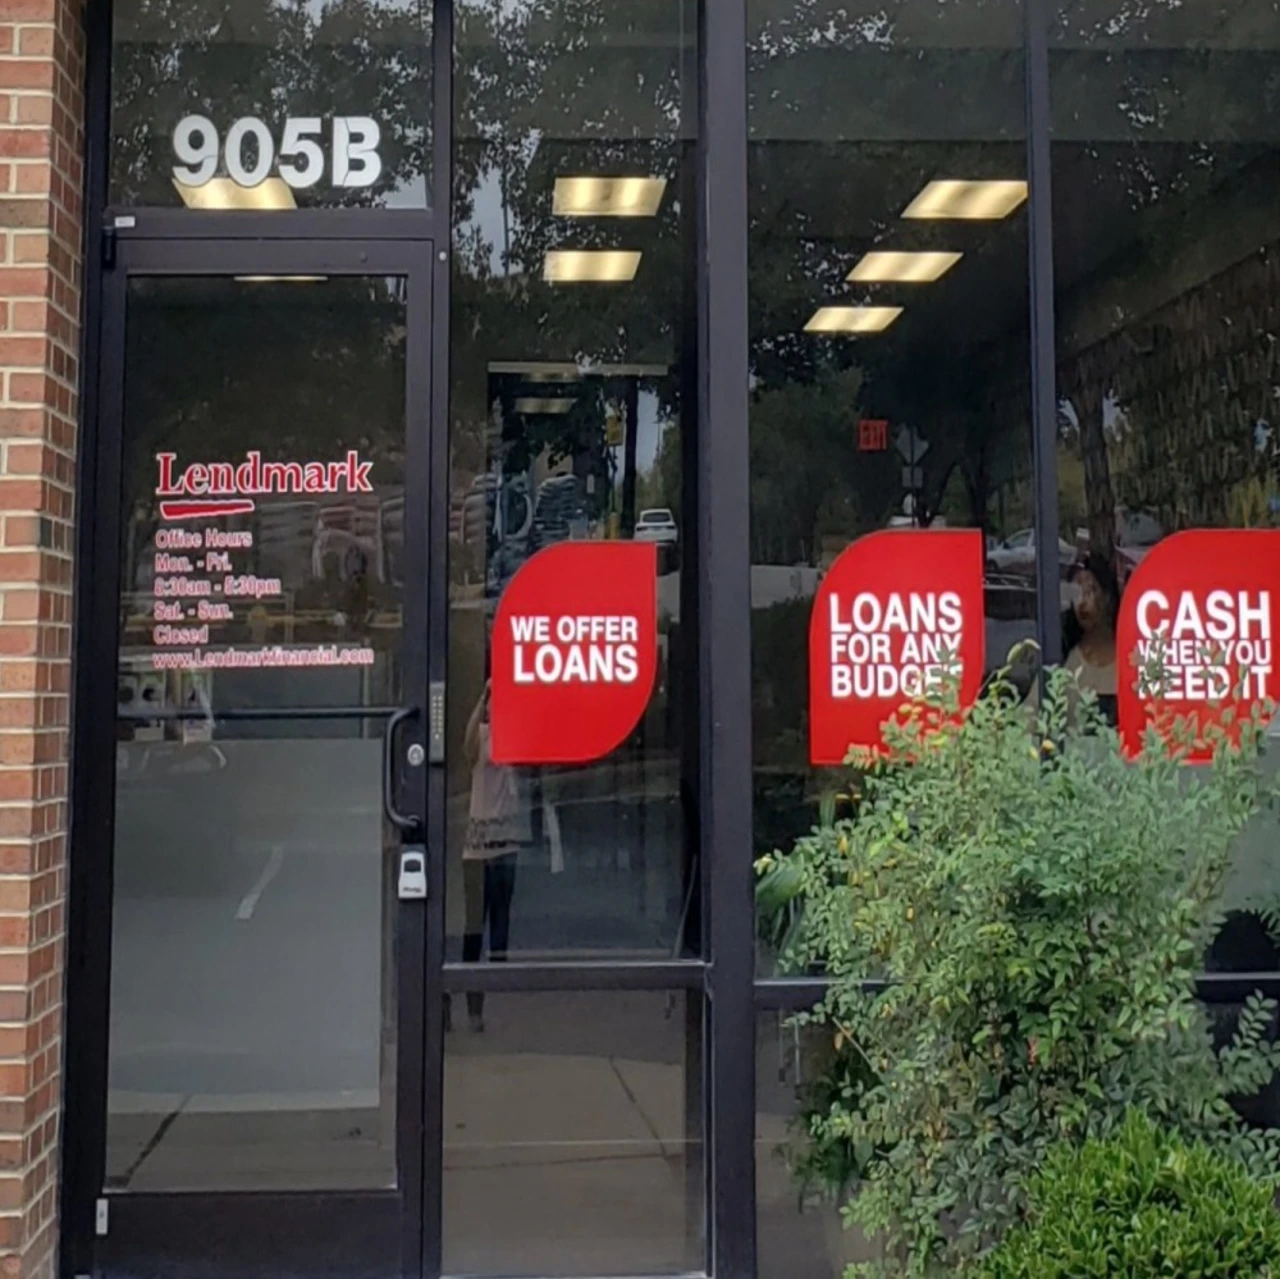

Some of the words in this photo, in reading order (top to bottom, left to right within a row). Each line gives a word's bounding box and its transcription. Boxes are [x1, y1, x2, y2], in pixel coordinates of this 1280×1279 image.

[171, 113, 382, 189] 905B
[155, 450, 374, 495] Lendmark
[155, 528, 202, 549] Office
[205, 527, 253, 548] Hours
[155, 552, 193, 573] Mon.
[206, 551, 233, 572] Fri.
[154, 600, 185, 621] Sat.
[198, 599, 234, 620] Sun.
[829, 591, 962, 633] LOANS
[1136, 589, 1271, 640] CASH
[153, 623, 209, 644] Closed
[510, 616, 551, 641] WE
[557, 615, 638, 642] OFFER
[830, 633, 891, 663] FOR
[900, 633, 962, 664] ANY
[1220, 639, 1272, 665] YOU
[514, 644, 638, 683] LOANS
